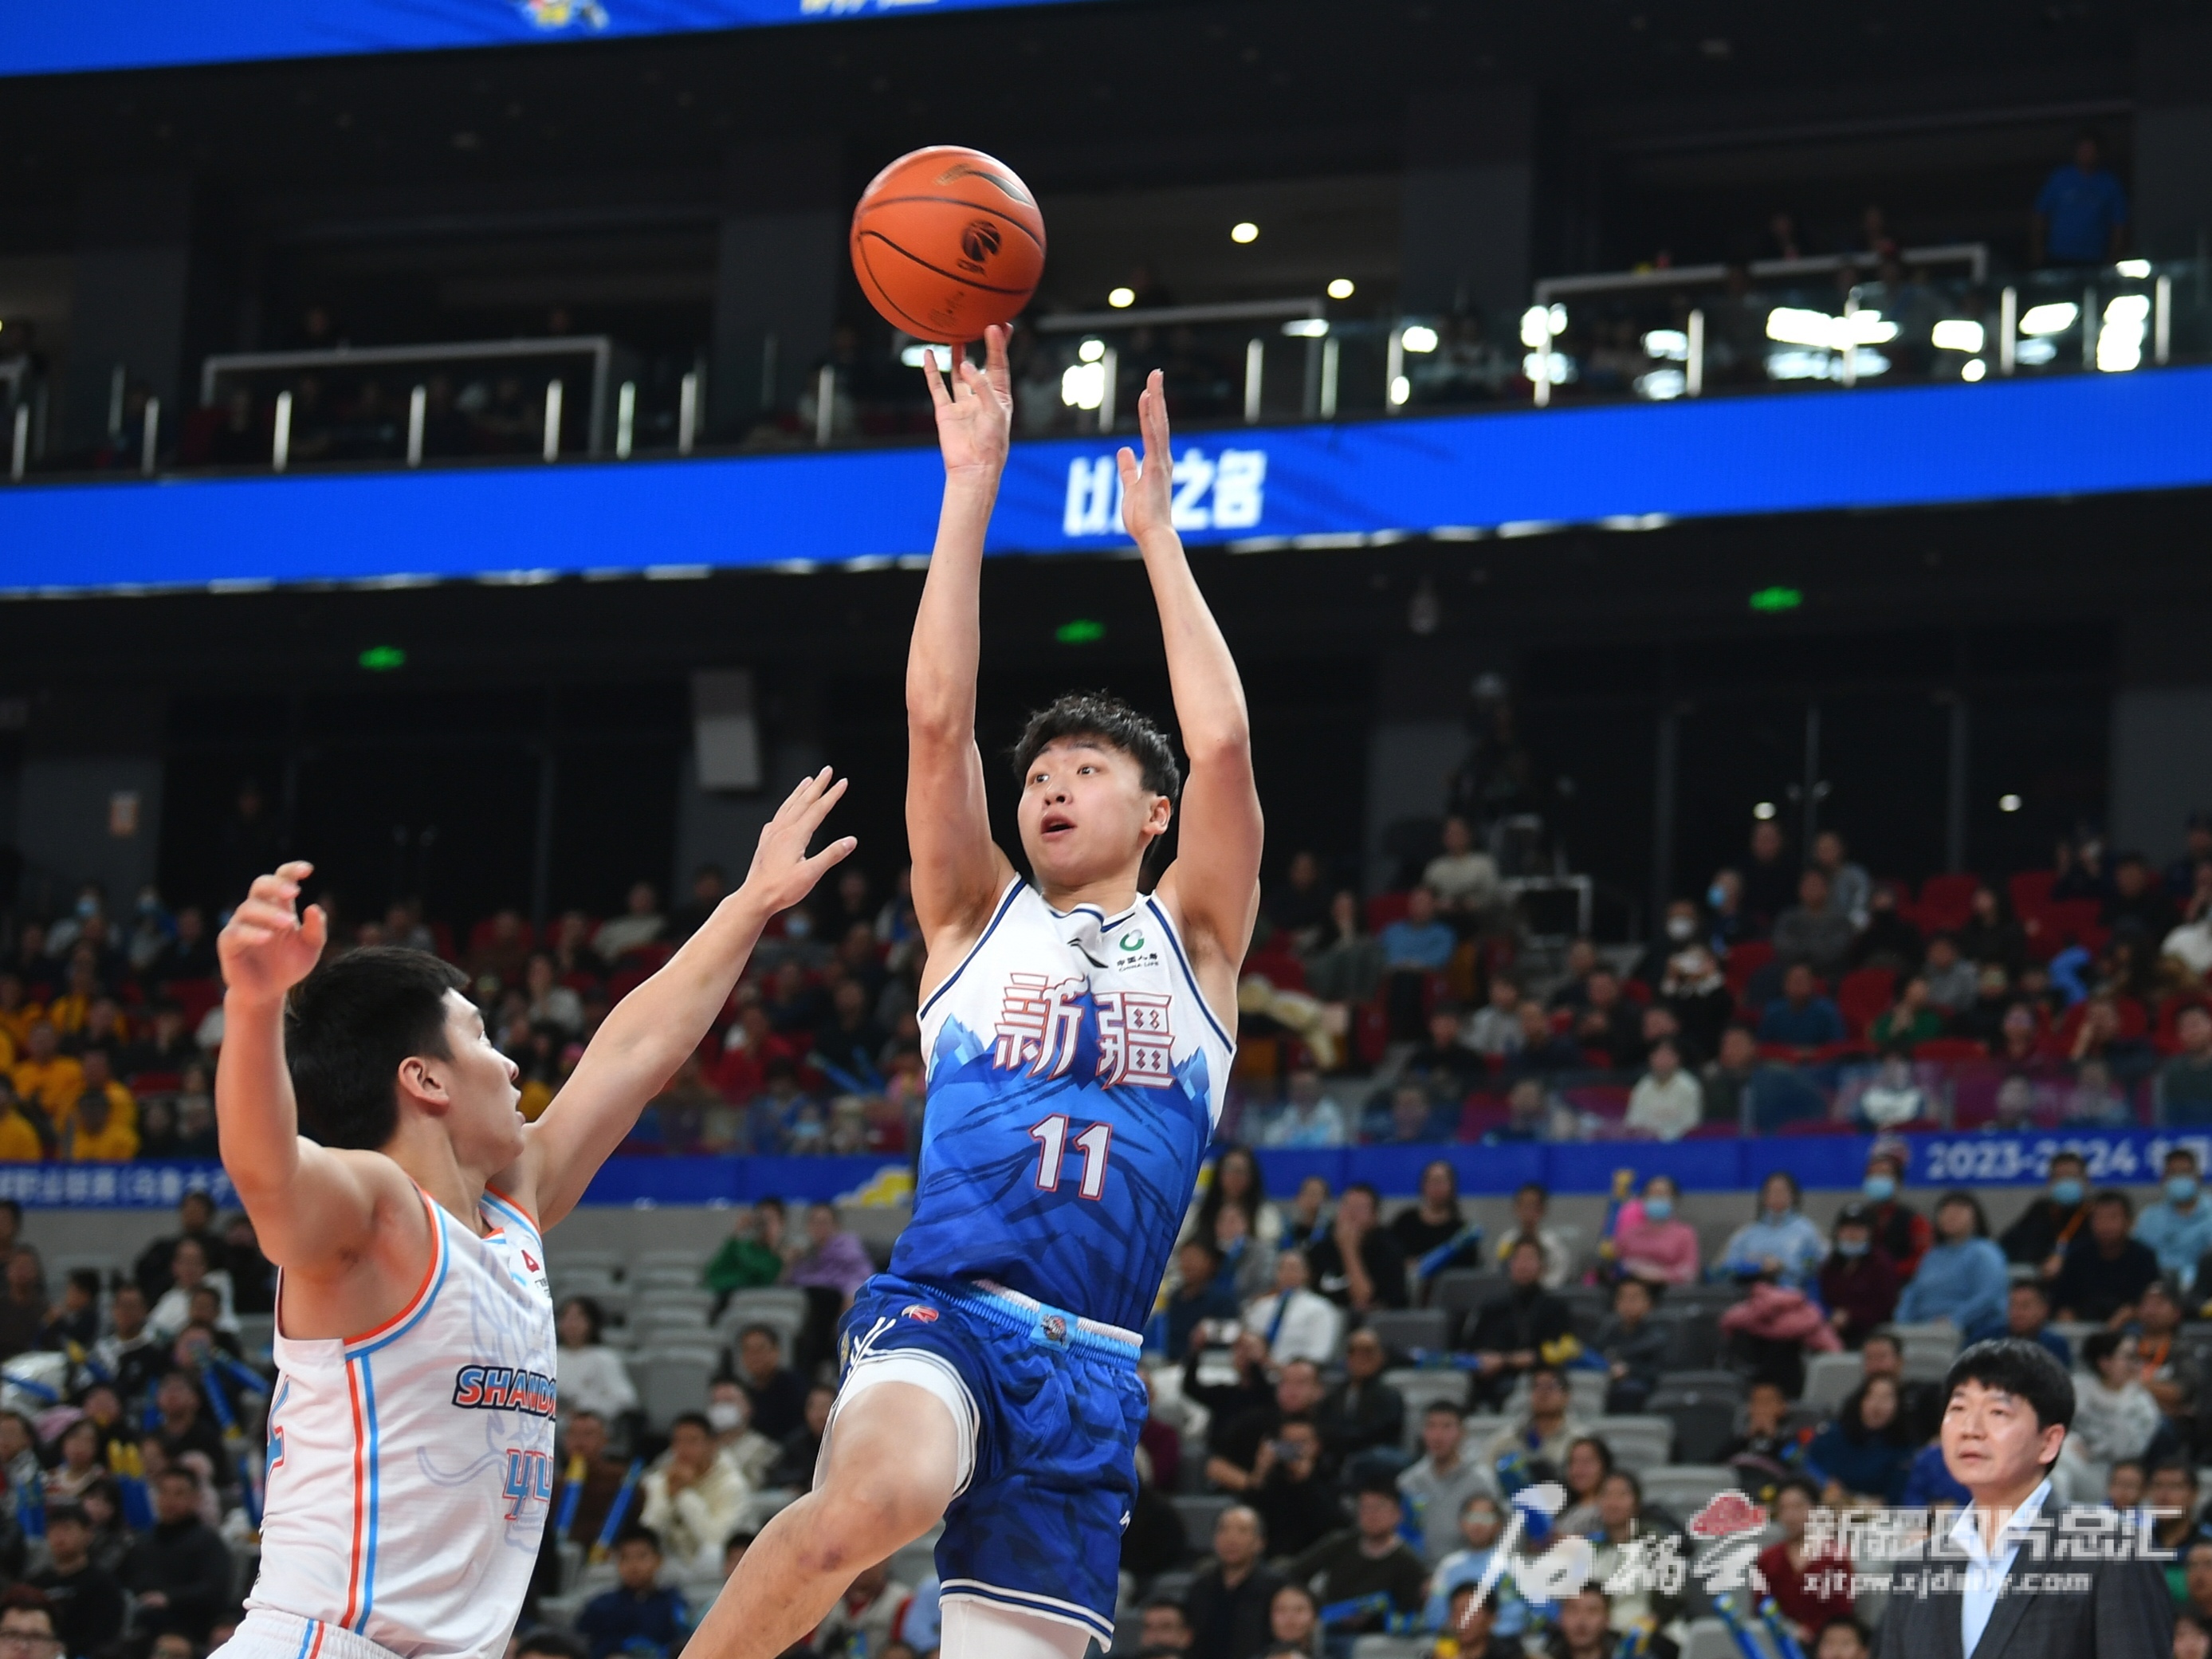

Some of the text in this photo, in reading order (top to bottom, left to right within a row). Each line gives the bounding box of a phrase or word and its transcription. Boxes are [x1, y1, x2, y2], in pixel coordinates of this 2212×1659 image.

[993, 973, 1176, 1090] 新疆
[1028, 1113, 1112, 1201] 11
[1926, 1137, 2138, 1180] 2023-224
